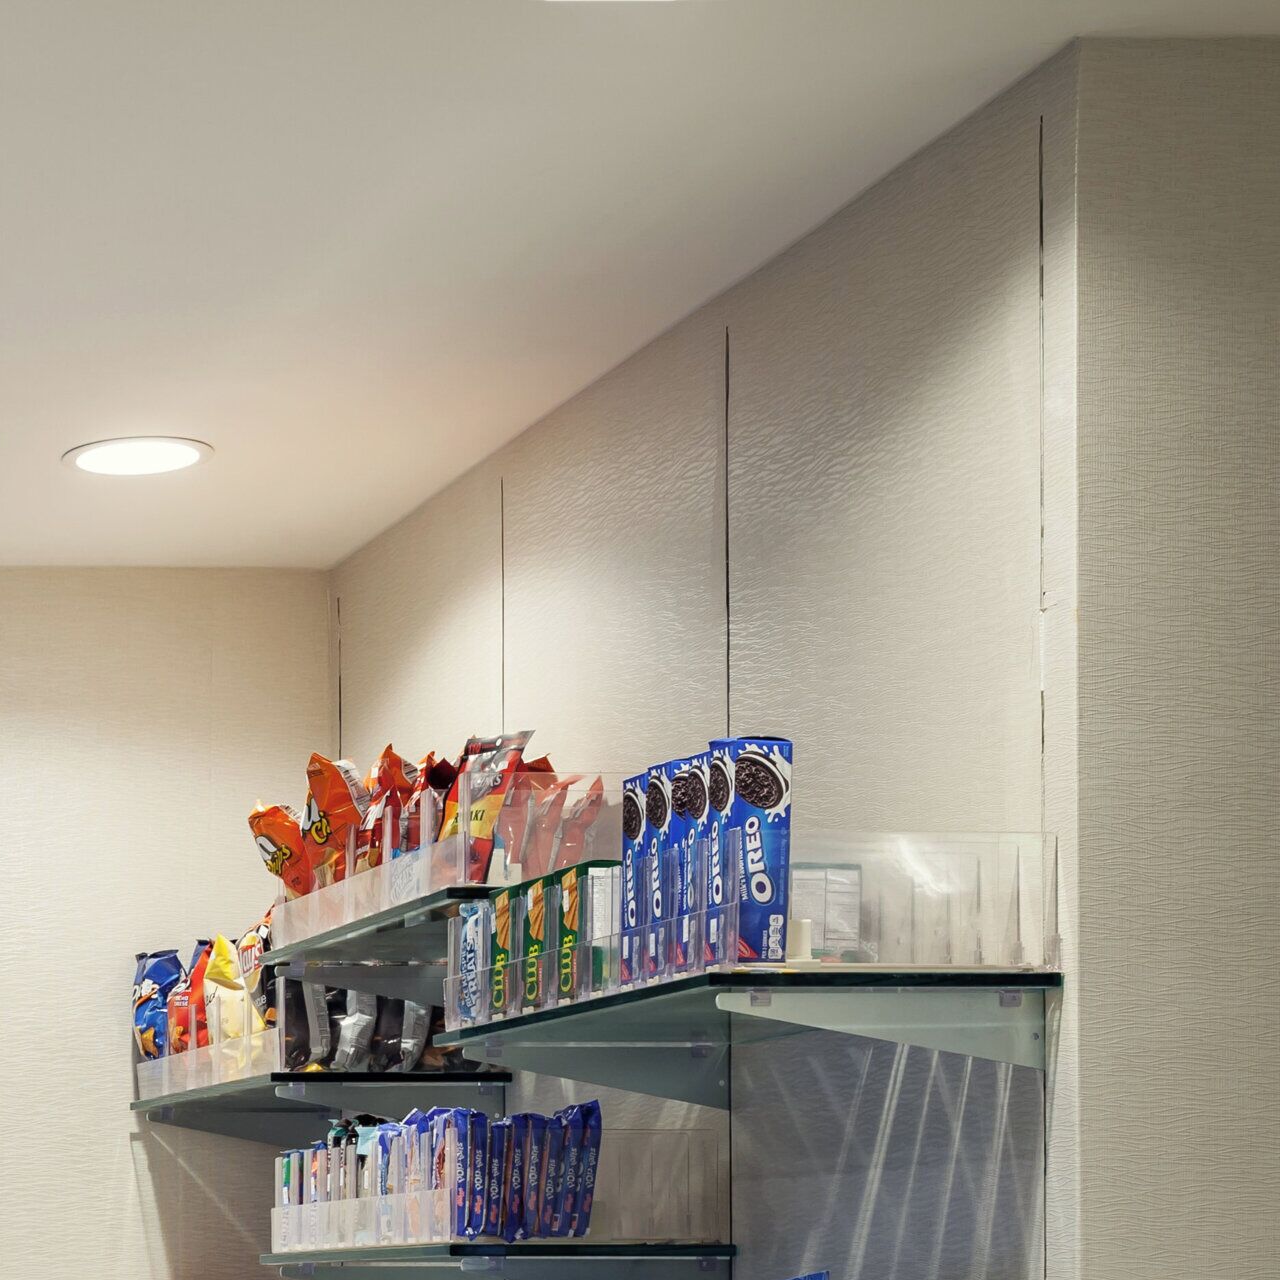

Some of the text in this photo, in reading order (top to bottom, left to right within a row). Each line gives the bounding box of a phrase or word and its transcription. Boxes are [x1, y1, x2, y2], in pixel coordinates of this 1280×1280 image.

[626, 849, 636, 927] OREO
[712, 821, 723, 905] OREO
[745, 816, 773, 905] OREO
[467, 939, 480, 1006] TREATS
[493, 953, 506, 1008] CLUB
[526, 944, 539, 1000] CLUB
[560, 935, 573, 992] CLUB
